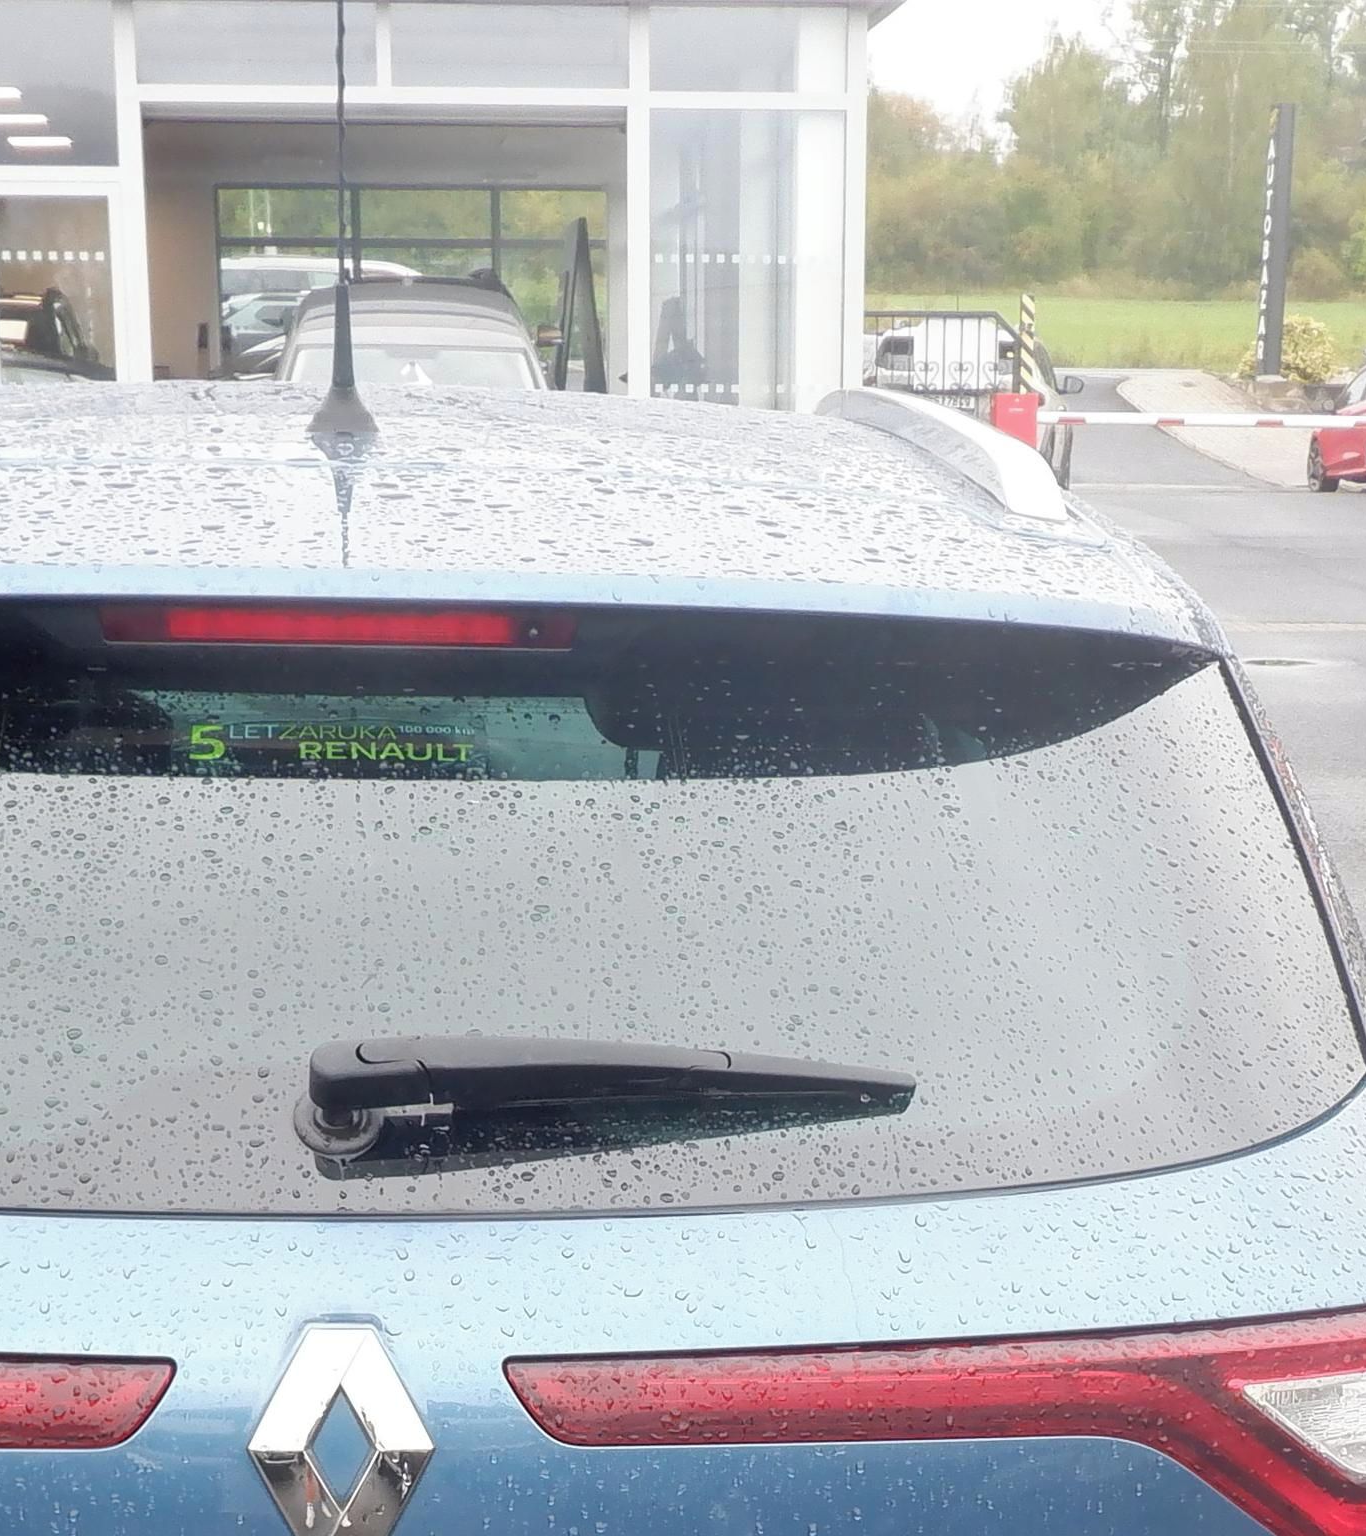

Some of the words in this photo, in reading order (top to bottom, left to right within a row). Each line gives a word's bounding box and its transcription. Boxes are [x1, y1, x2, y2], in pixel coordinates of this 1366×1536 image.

[1256, 138, 1276, 361] AUTOBAZAR
[189, 724, 226, 760] 5
[229, 724, 279, 739] LET
[399, 725, 422, 735] 100
[425, 726, 452, 735] 000
[299, 741, 475, 762] RENAULT
